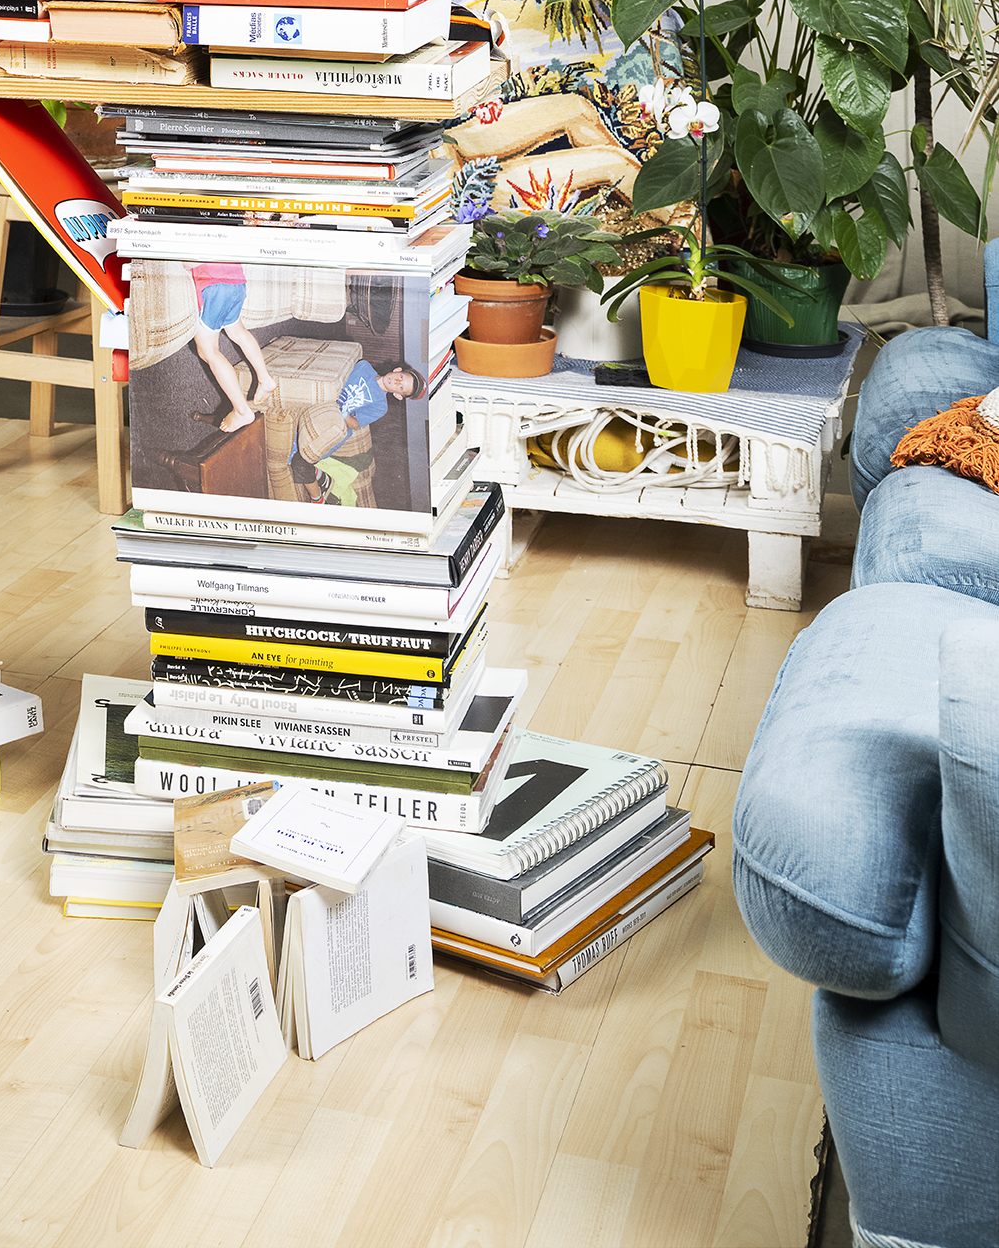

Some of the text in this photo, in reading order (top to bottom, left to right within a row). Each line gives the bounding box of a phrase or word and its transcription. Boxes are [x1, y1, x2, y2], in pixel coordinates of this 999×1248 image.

[249, 12, 257, 43] Médias
[232, 70, 304, 80] OLIVER SACKS
[315, 66, 402, 89] MUSICOPHILIA
[159, 123, 215, 133] Pierre Savatier
[218, 198, 352, 213] ANIMAUX A MIMER
[63, 216, 91, 242] AU
[154, 515, 298, 536] WALKER EVANS L'AMÉRIQUE
[459, 529, 484, 575] HENRY DARGER
[196, 579, 269, 595] Wolfgang Tillmans
[327, 592, 387, 604] FONDATION BEYELER
[245, 624, 432, 651] HITCHCOCK/TRUFFAUT
[251, 652, 335, 669] AN EYE for painting
[169, 688, 207, 703] plaisir
[208, 694, 223, 705] Le
[229, 693, 266, 711] Dufy
[267, 698, 298, 714] Raoul
[212, 714, 352, 737] PIKIN SLEE VIVIANE SASSEN
[402, 733, 435, 744] PRESTEL
[459, 802, 467, 828] STEIDL
[472, 891, 501, 905] ACTES SUD
[572, 927, 618, 975] THOMAS RUFF
